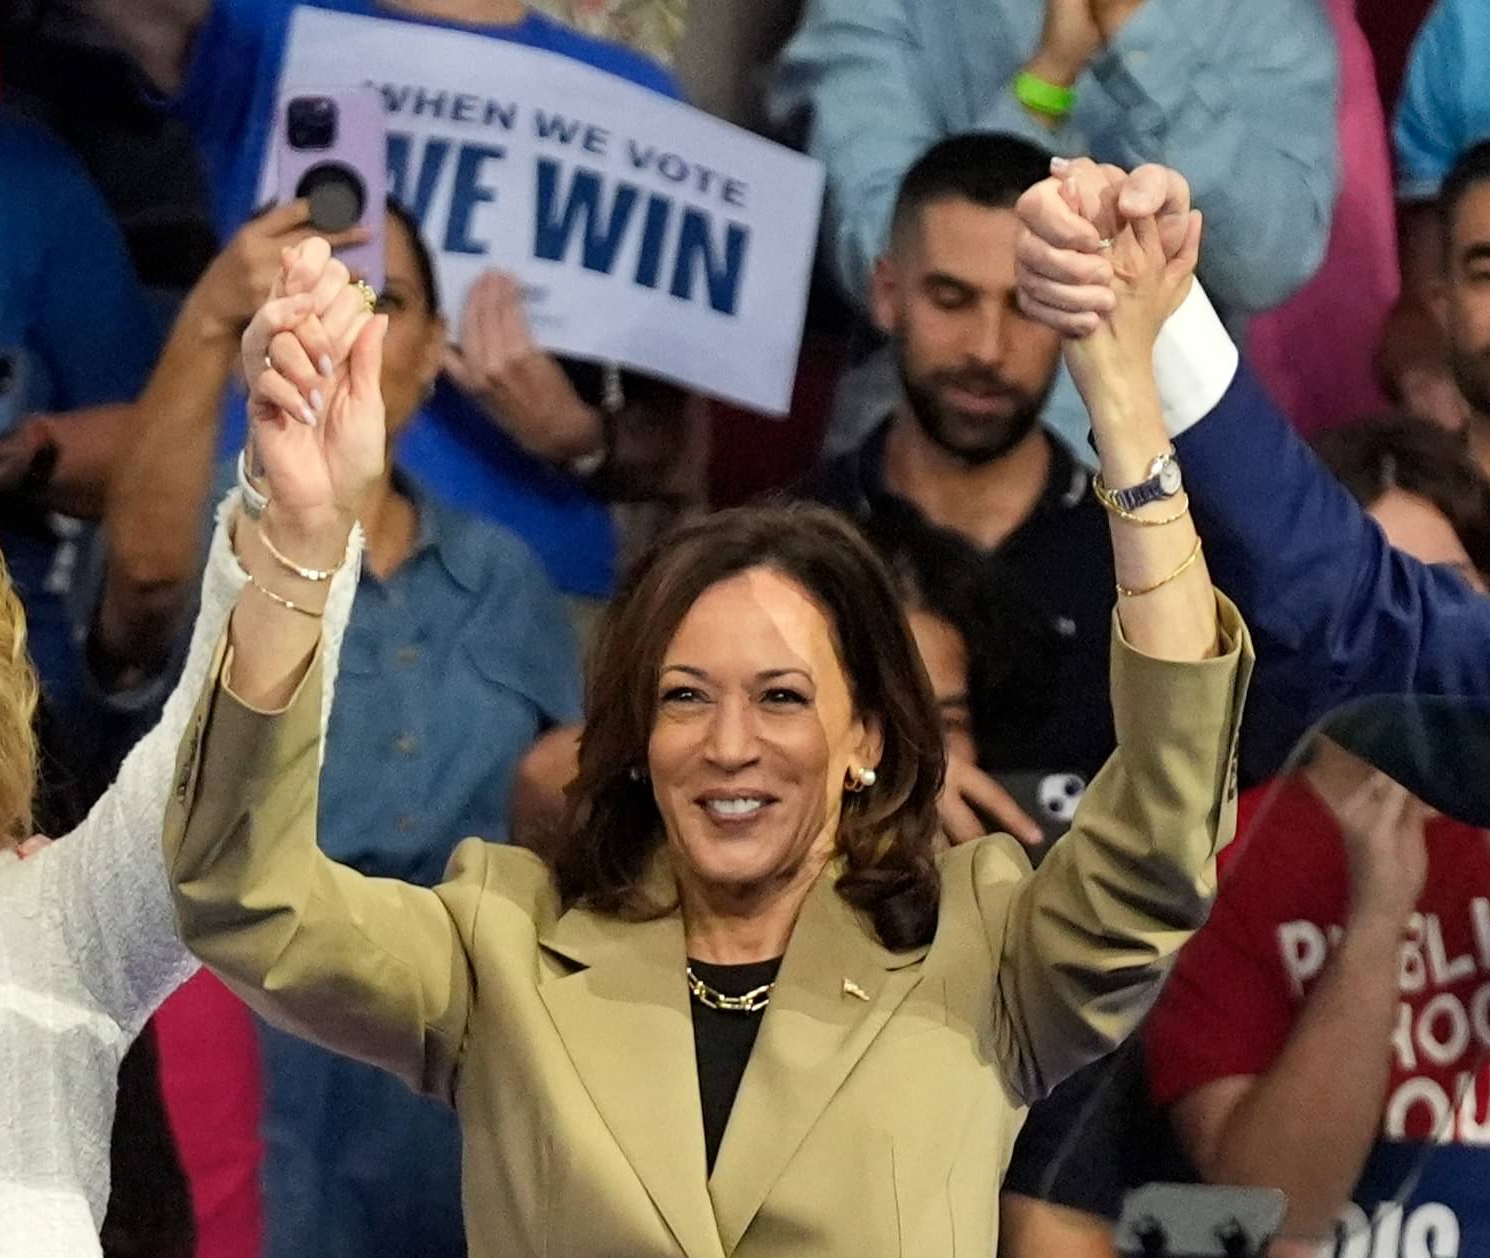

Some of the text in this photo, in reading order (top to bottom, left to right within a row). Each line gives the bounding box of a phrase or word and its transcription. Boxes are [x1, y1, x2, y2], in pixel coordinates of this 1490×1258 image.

[535, 107, 610, 156] WE
[627, 137, 751, 209] VOTE
[533, 153, 751, 317] WIN
